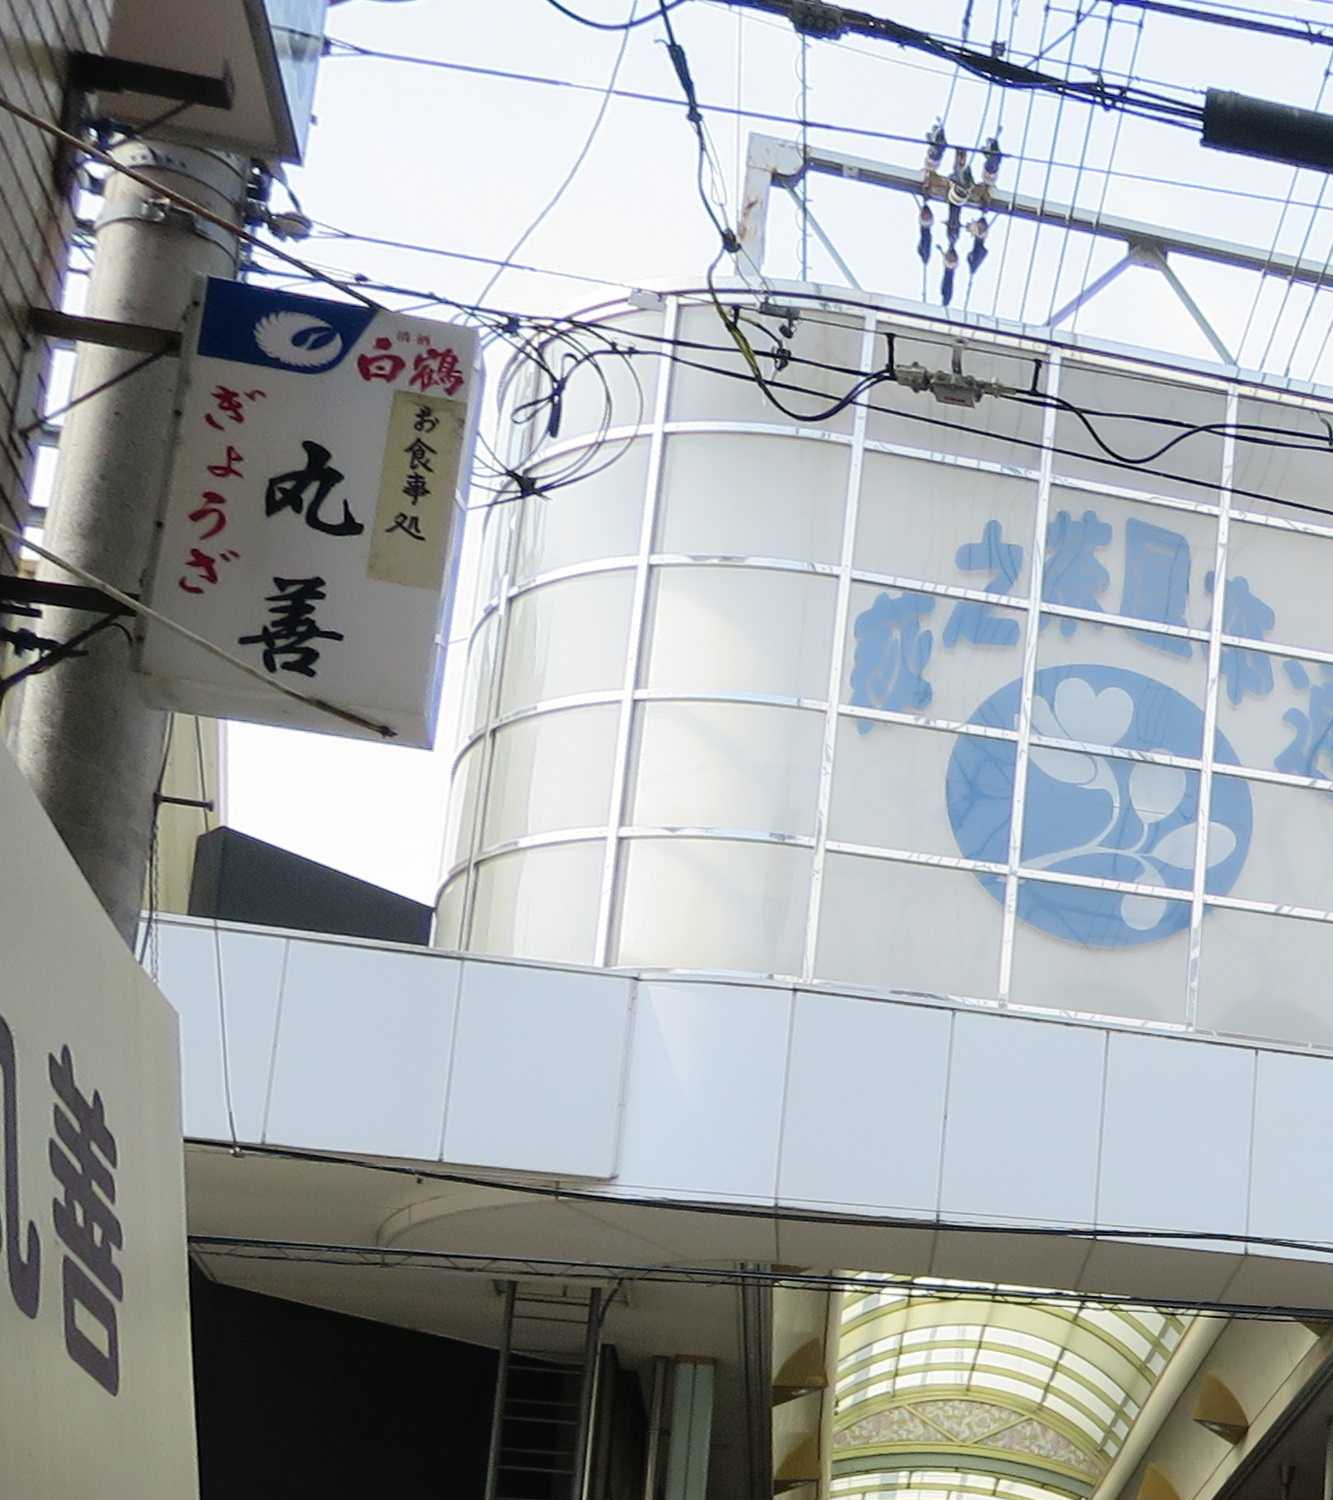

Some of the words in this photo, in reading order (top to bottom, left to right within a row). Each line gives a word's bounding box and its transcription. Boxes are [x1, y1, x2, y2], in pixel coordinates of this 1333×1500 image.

[356, 336, 465, 397] 白鶴
[179, 385, 267, 595] ぎょうざ
[238, 440, 365, 678] 丸善
[384, 404, 441, 542] お食事処
